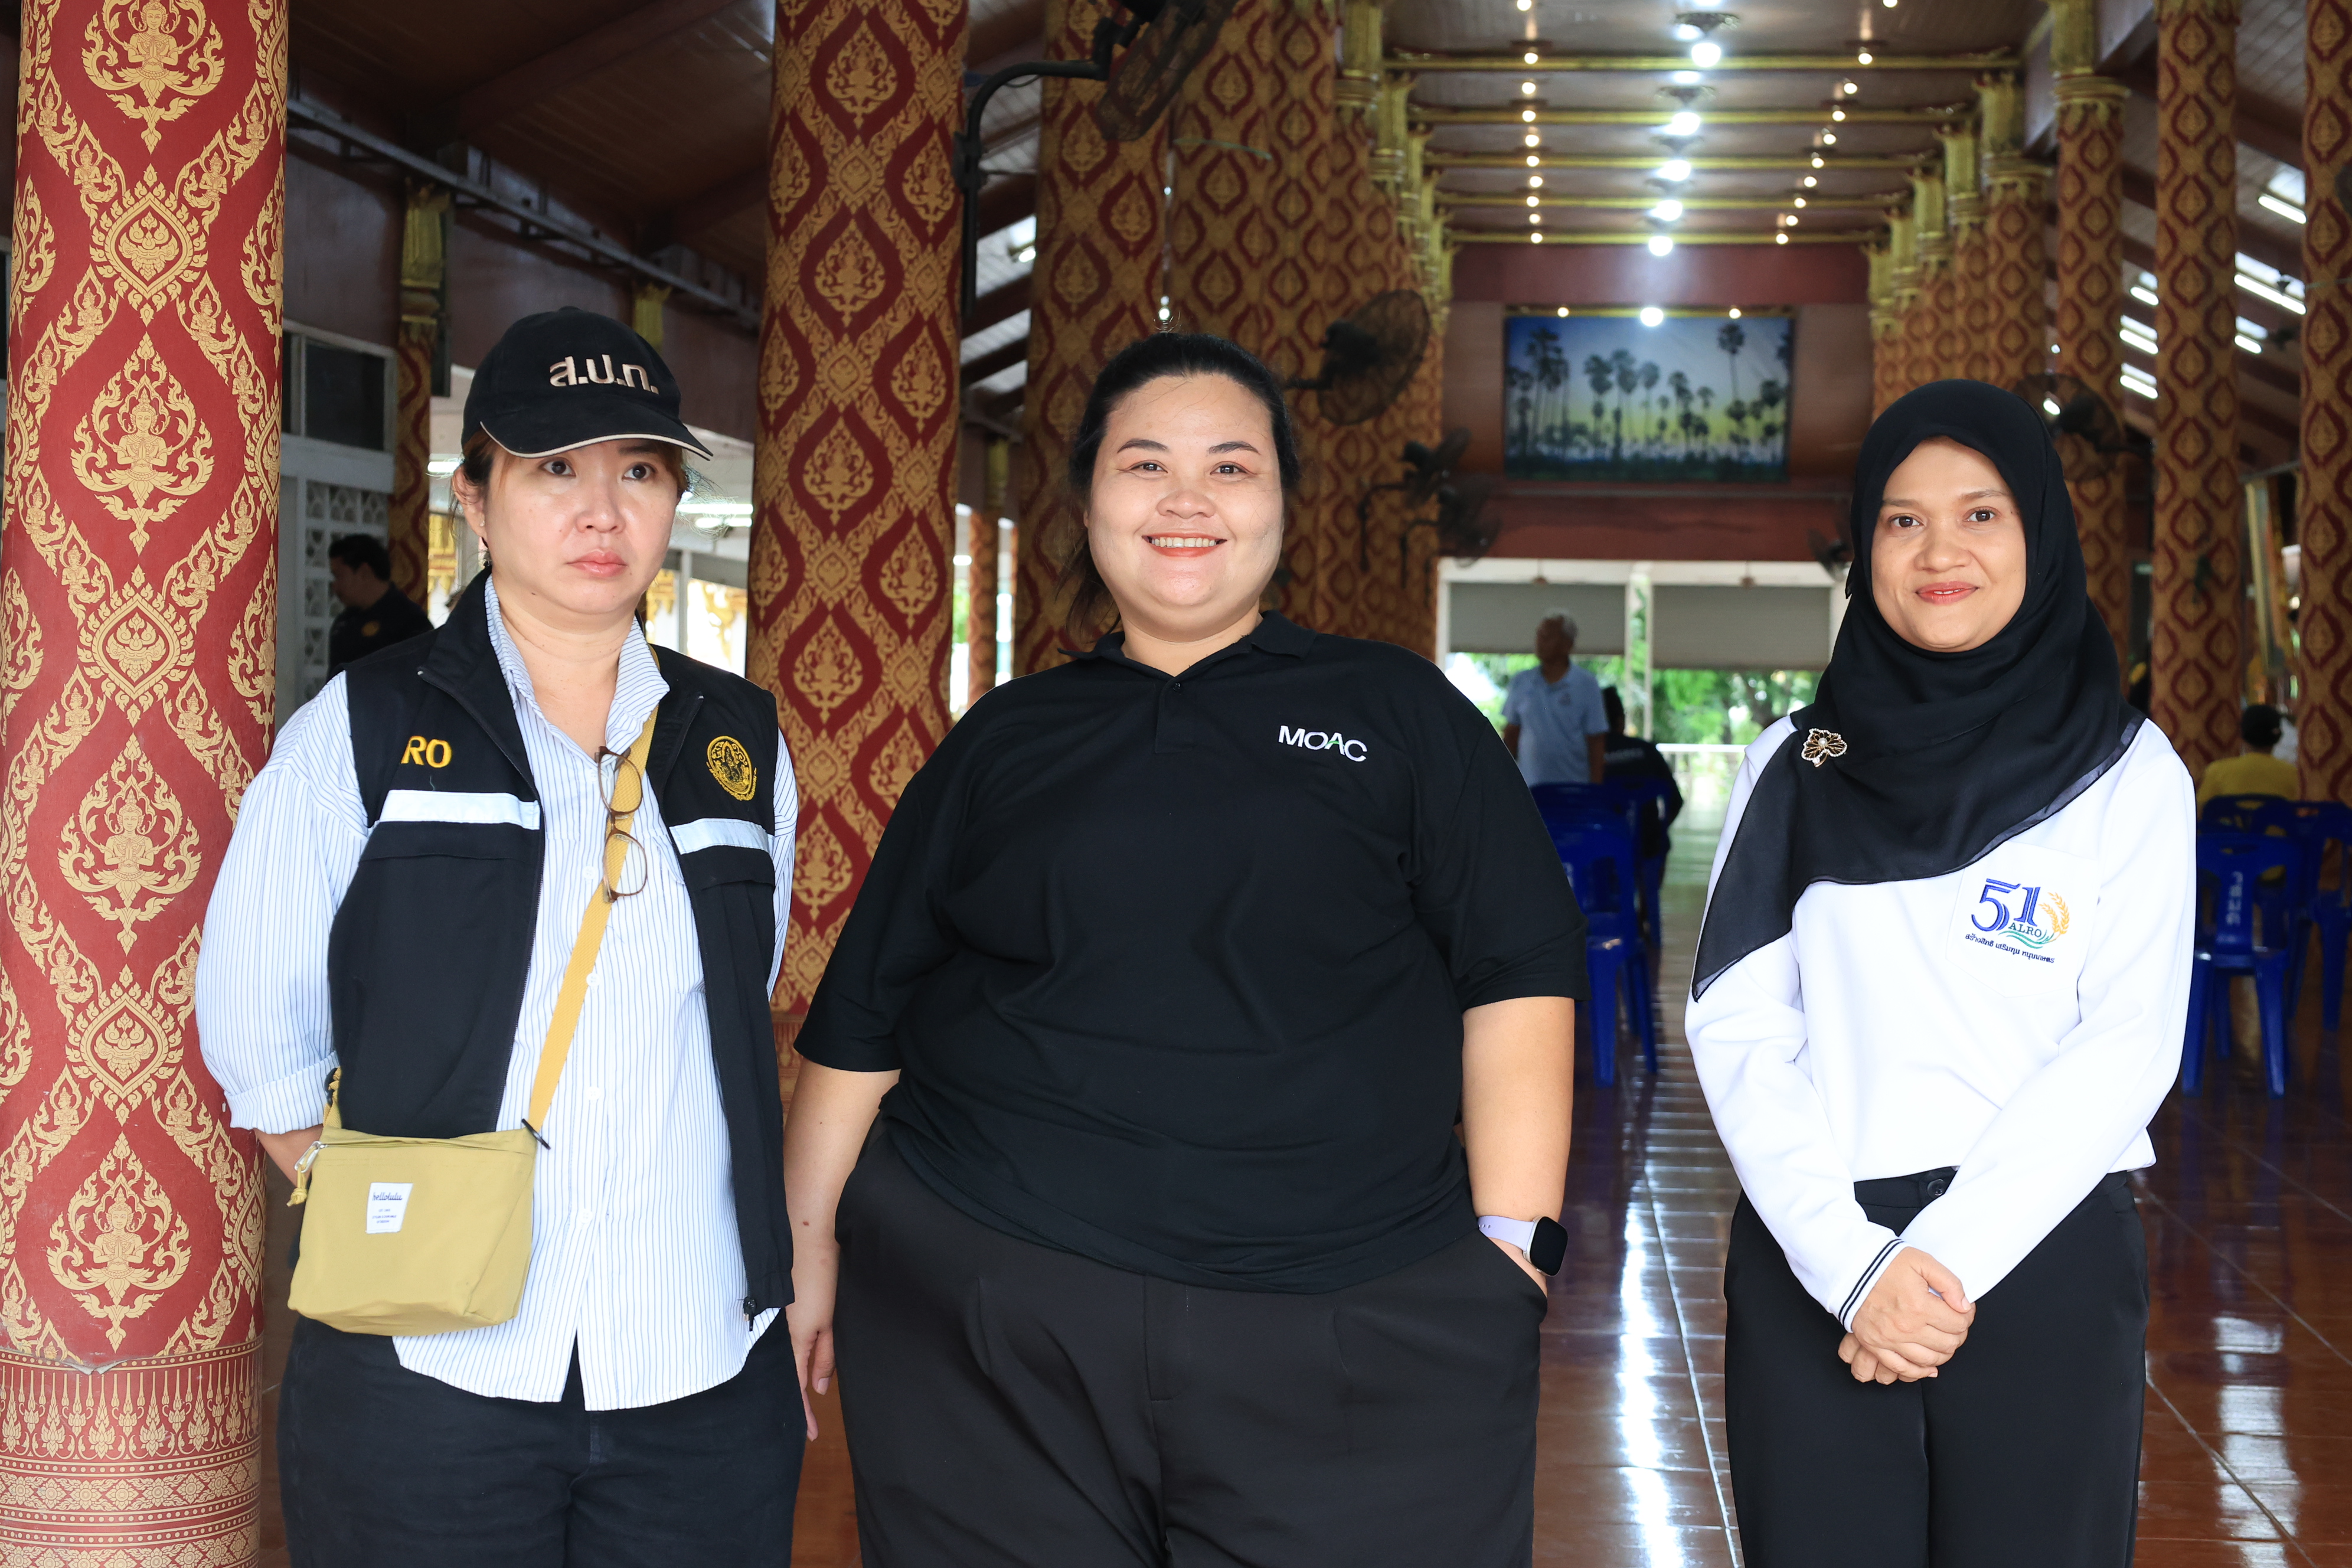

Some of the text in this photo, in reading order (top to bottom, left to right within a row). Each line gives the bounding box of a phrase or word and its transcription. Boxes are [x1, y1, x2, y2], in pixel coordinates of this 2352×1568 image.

[550, 354, 659, 394] ส.ป.ก.
[401, 736, 452, 768] RO
[1278, 725, 1367, 762] MOAC
[1971, 878, 2041, 932] 51
[2008, 922, 2041, 937] ALRO
[372, 1192, 403, 1201] hellolulu
